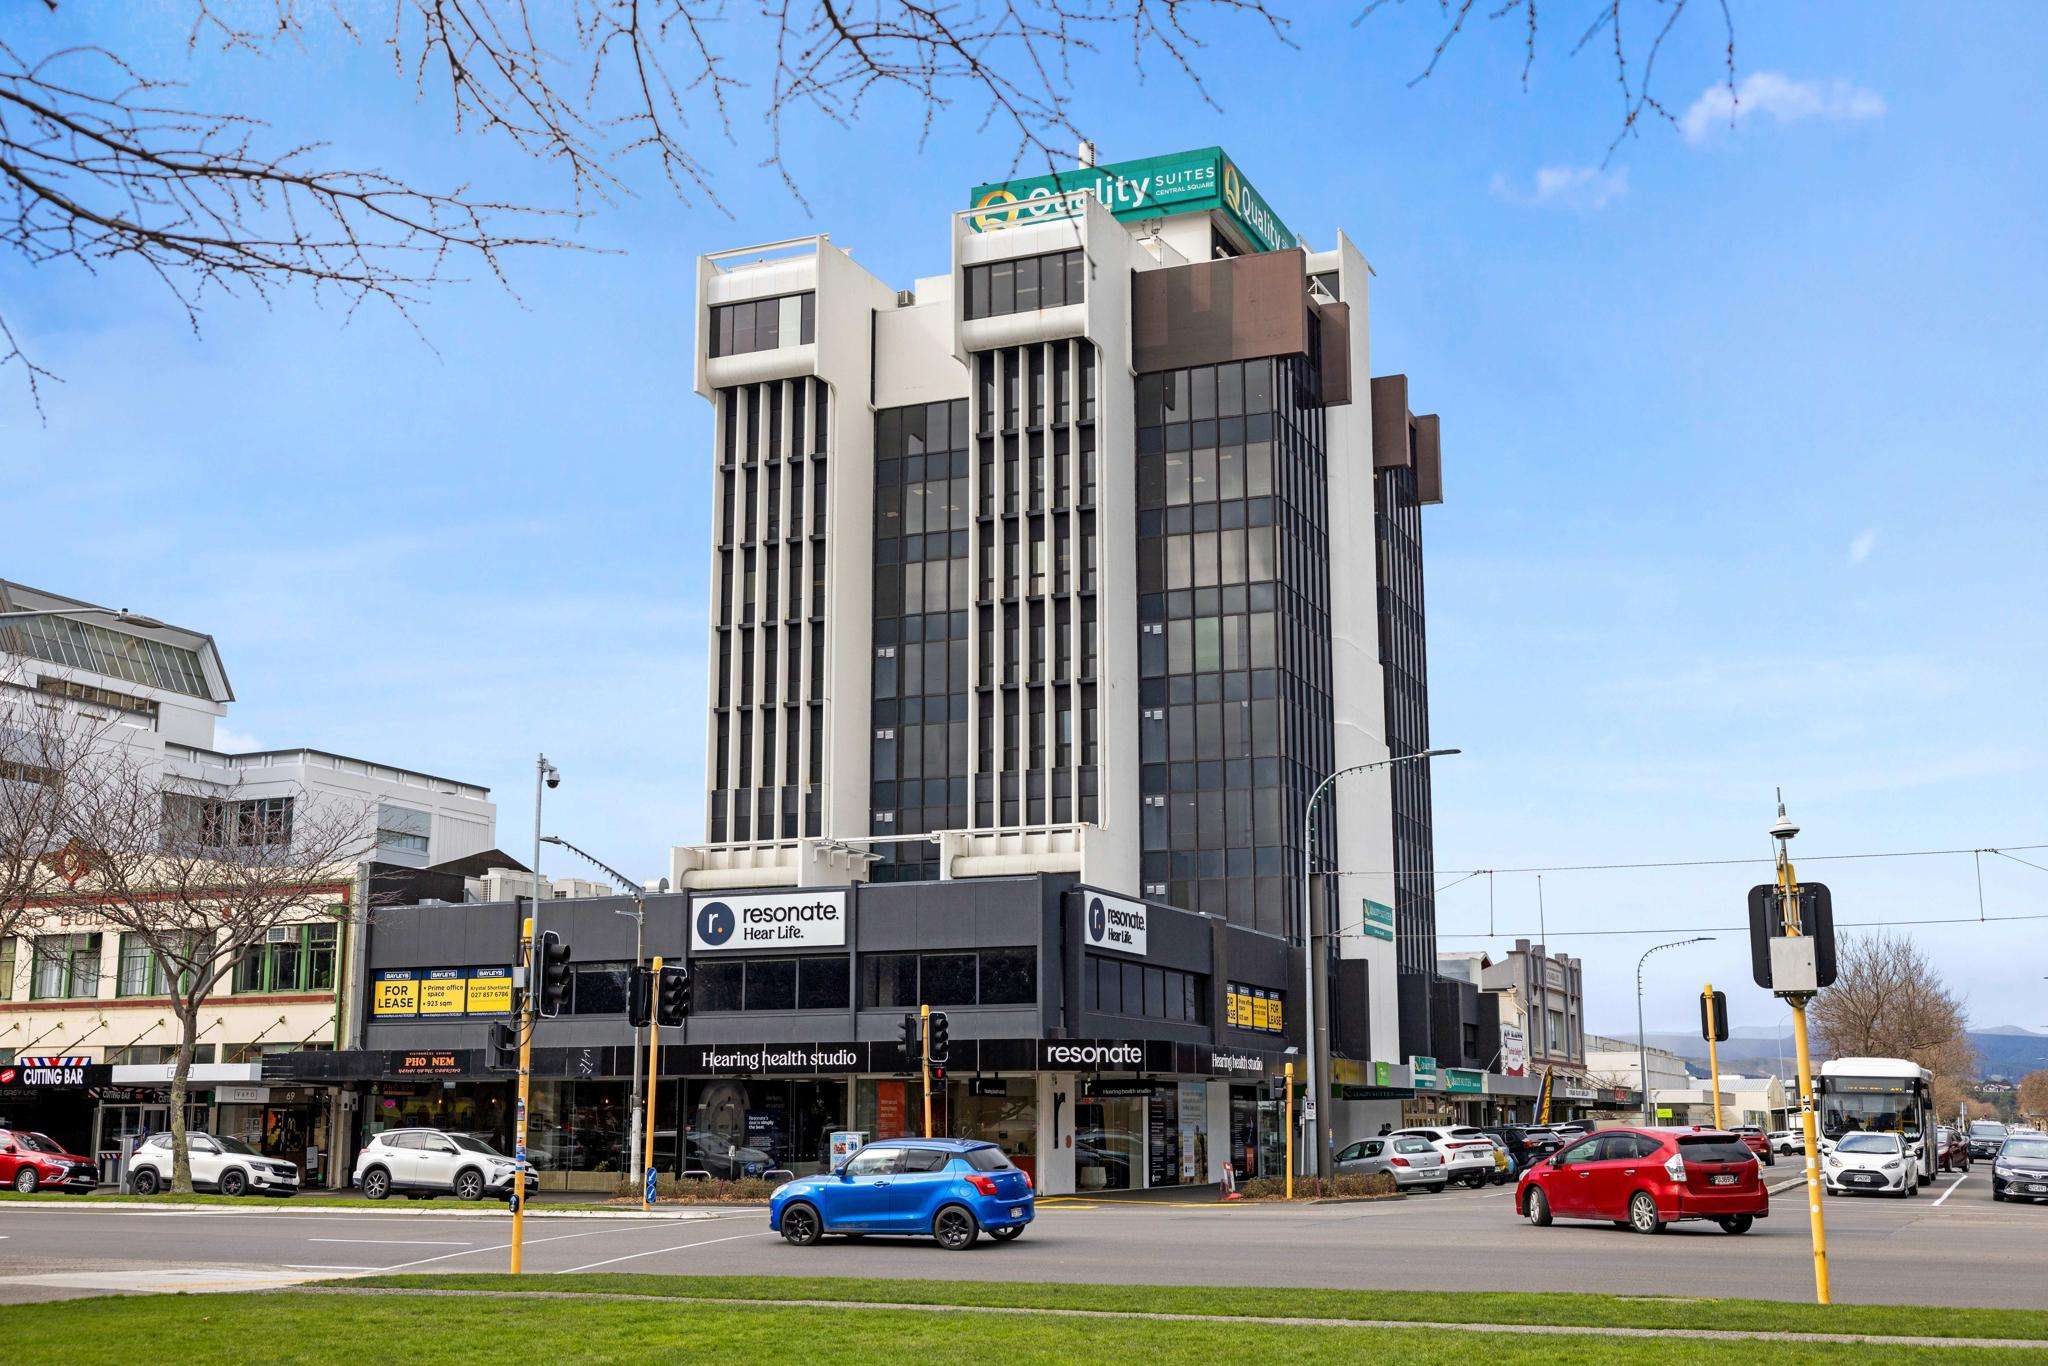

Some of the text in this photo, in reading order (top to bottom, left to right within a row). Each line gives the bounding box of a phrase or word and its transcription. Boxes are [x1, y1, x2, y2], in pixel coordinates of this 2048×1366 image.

[1155, 166, 1215, 186] SUITES
[1028, 175, 1150, 216] Quality
[1155, 181, 1215, 196] CENTRAL SQUARE
[1242, 186, 1281, 251] Quality
[743, 901, 840, 924] resonate.
[1107, 908, 1146, 931] resonate.
[743, 925, 804, 941] Hear Life.
[1108, 927, 1133, 945] Hear Life.
[479, 969, 504, 977] BAYLEYS
[385, 986, 409, 996] FOR
[378, 997, 414, 1009] LEASE
[404, 1056, 455, 1067] PHO NEM
[702, 1049, 857, 1070] Hearing health studio
[1047, 1043, 1142, 1063] resonate
[1212, 1053, 1263, 1072] Hearing health studio
[23, 1068, 63, 1085] CUTTING
[64, 1068, 84, 1085] BAR
[286, 1091, 295, 1101] 69
